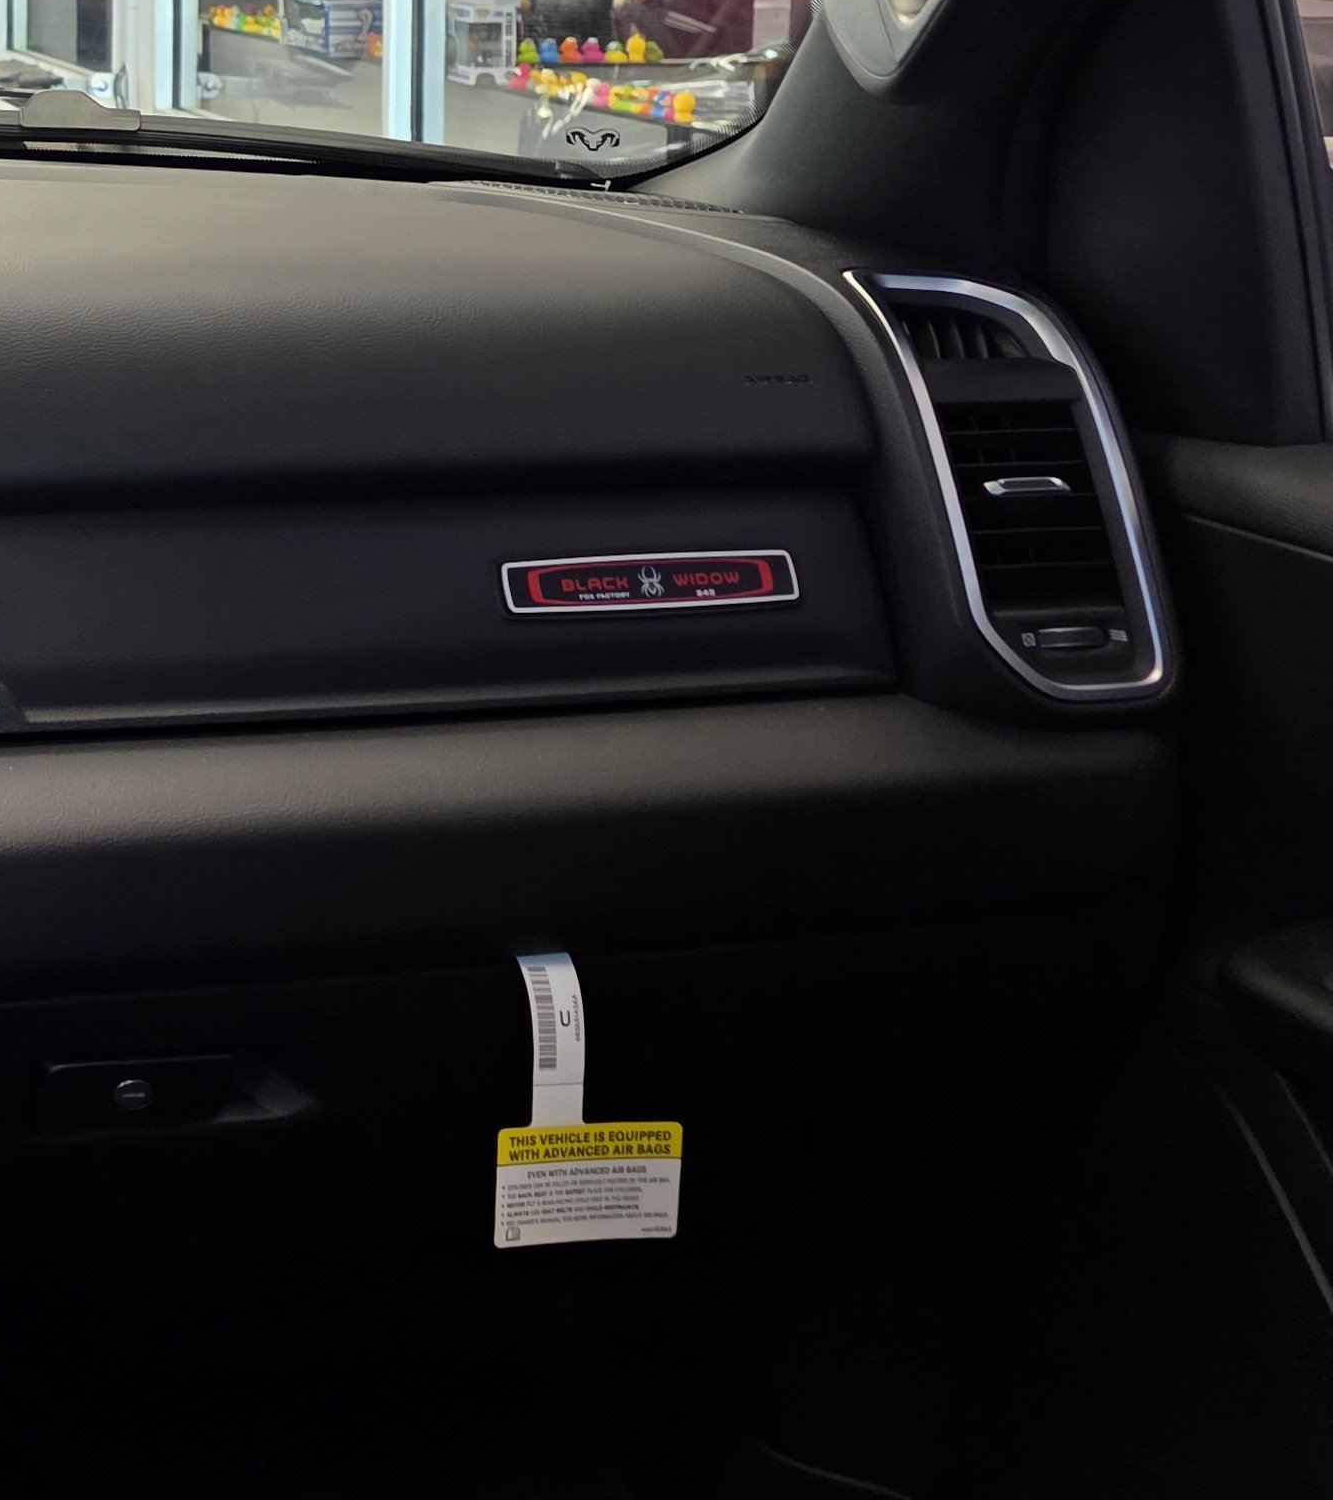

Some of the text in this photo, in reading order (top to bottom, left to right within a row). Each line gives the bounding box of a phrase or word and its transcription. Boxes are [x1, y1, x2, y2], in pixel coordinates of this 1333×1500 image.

[560, 570, 740, 593] BLACK WIDOW
[509, 1130, 672, 1148] THIS VEHICLE IS EQUIPPED
[508, 1143, 671, 1161] WITH ADVANCED AIR BAGS
[527, 1165, 647, 1180] EVEN WITH ADVANCED AIR BAGS
